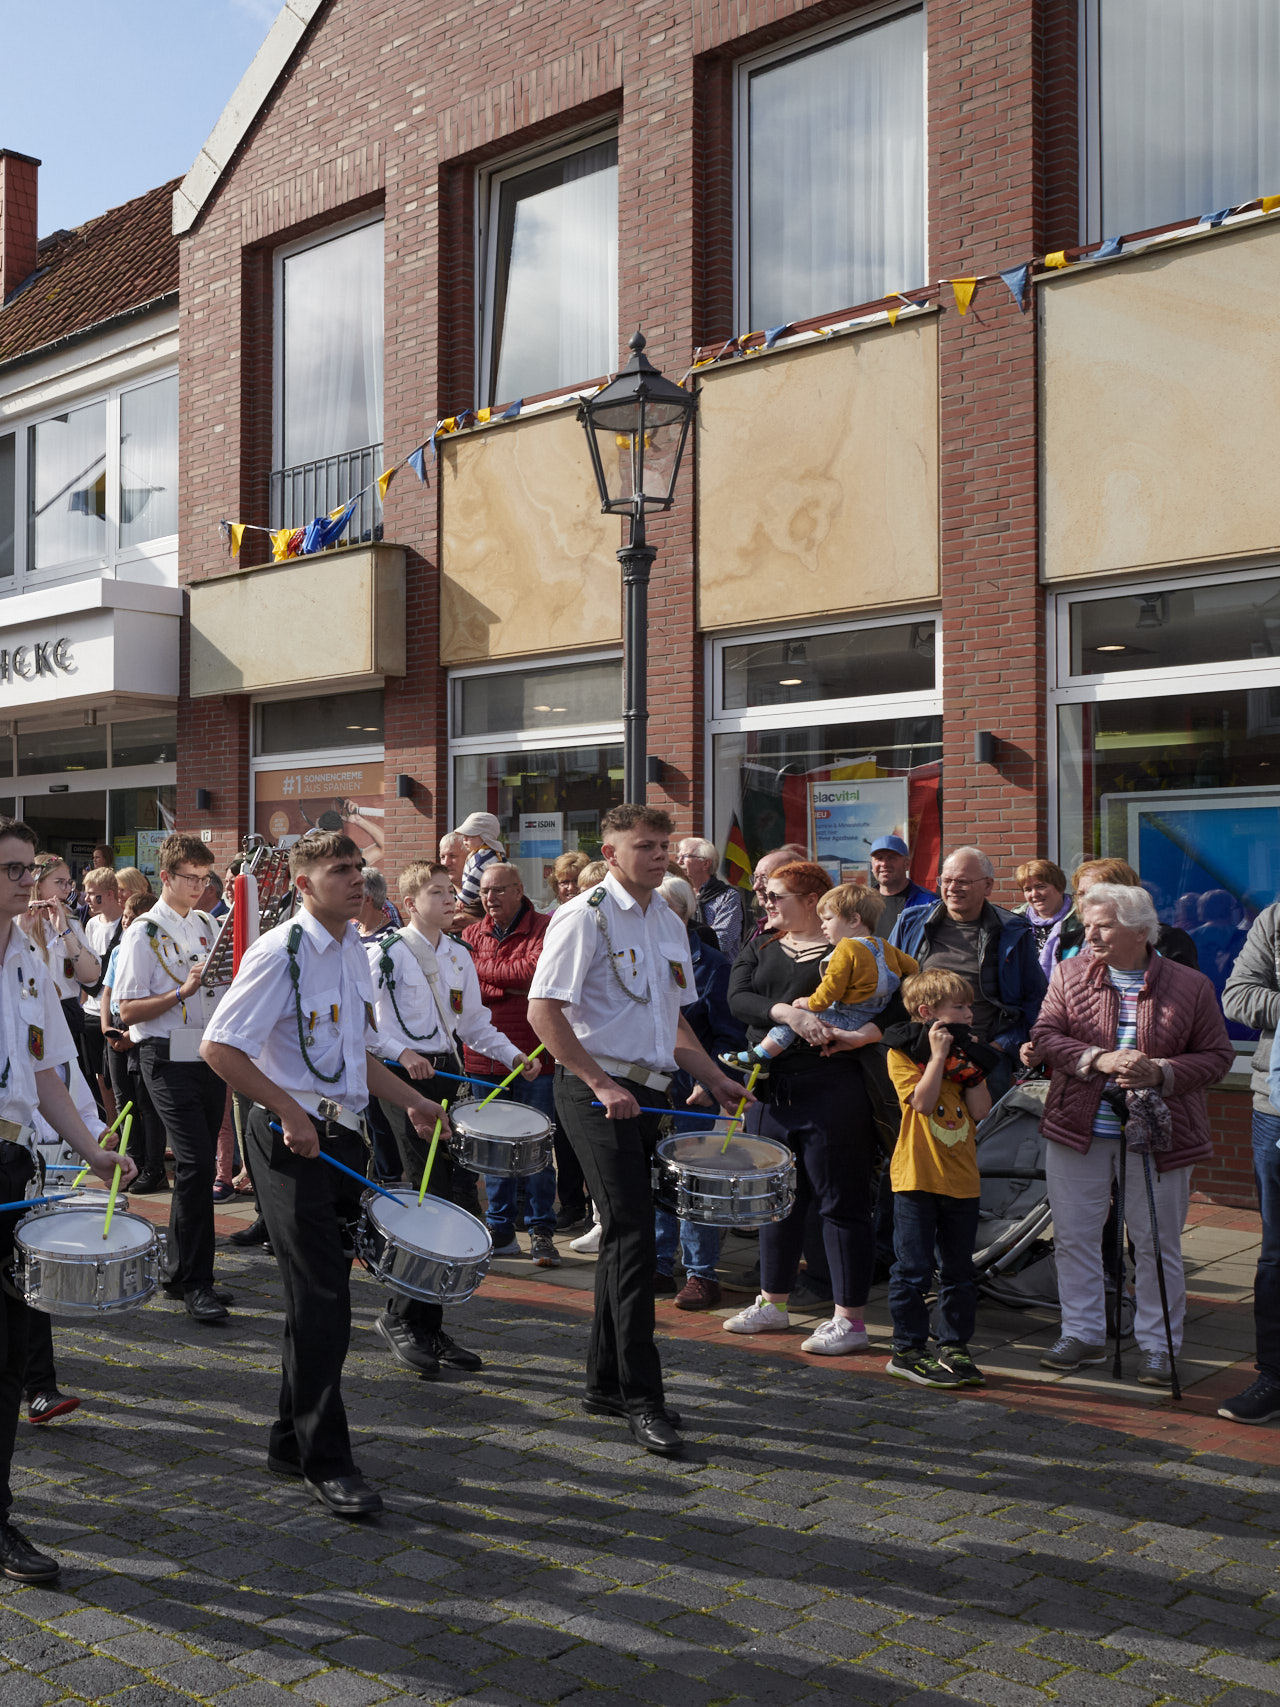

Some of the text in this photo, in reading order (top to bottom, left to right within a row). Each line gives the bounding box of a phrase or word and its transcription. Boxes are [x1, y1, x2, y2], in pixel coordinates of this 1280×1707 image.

[304, 771, 363, 783] SONNENCREME
[282, 775, 302, 795] #1
[304, 784, 321, 793] AUS
